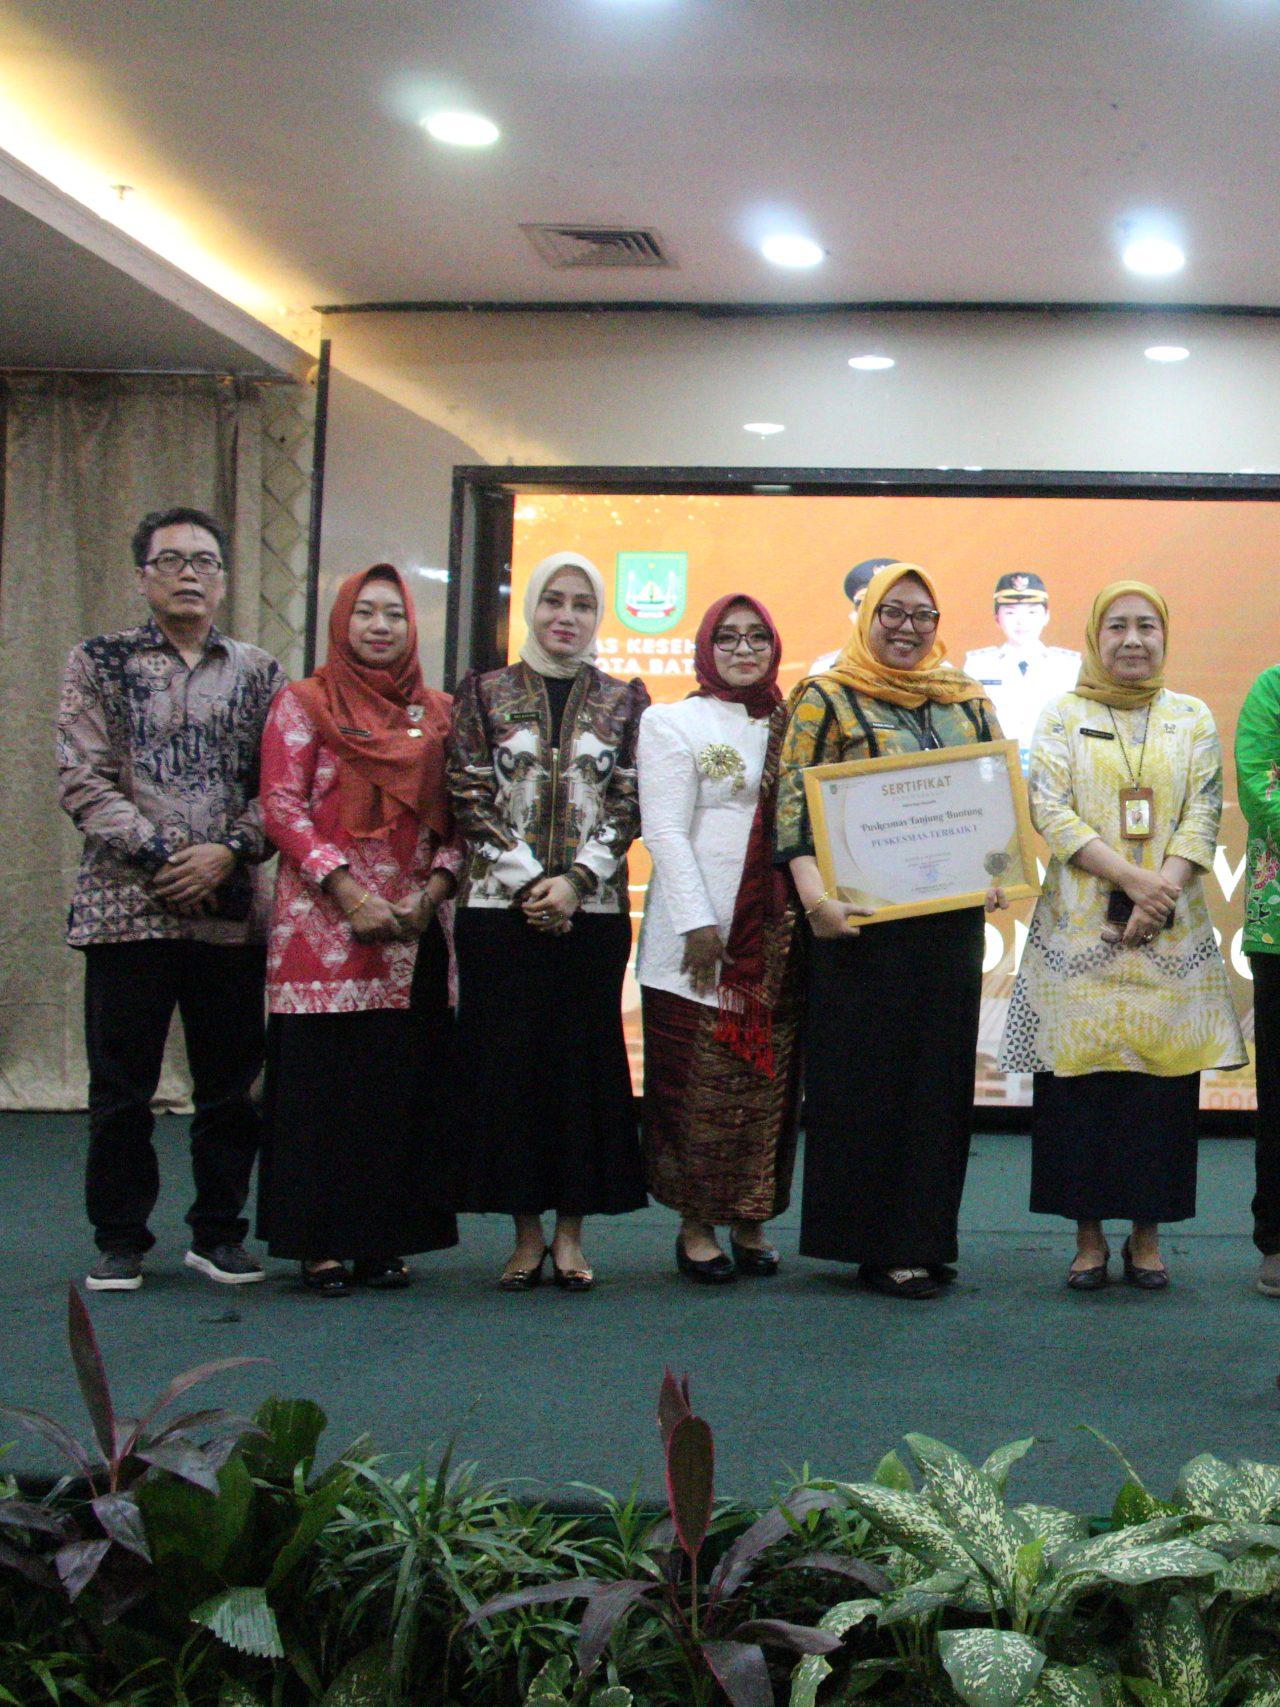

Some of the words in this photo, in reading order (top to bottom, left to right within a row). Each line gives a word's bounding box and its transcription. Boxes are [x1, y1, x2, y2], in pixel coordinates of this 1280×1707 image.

[881, 776, 952, 796] SERTIFIKAT
[862, 819, 908, 832] Puskesmas
[871, 832, 929, 848] PUSKESMAS
[930, 825, 971, 838] TERBAIK
